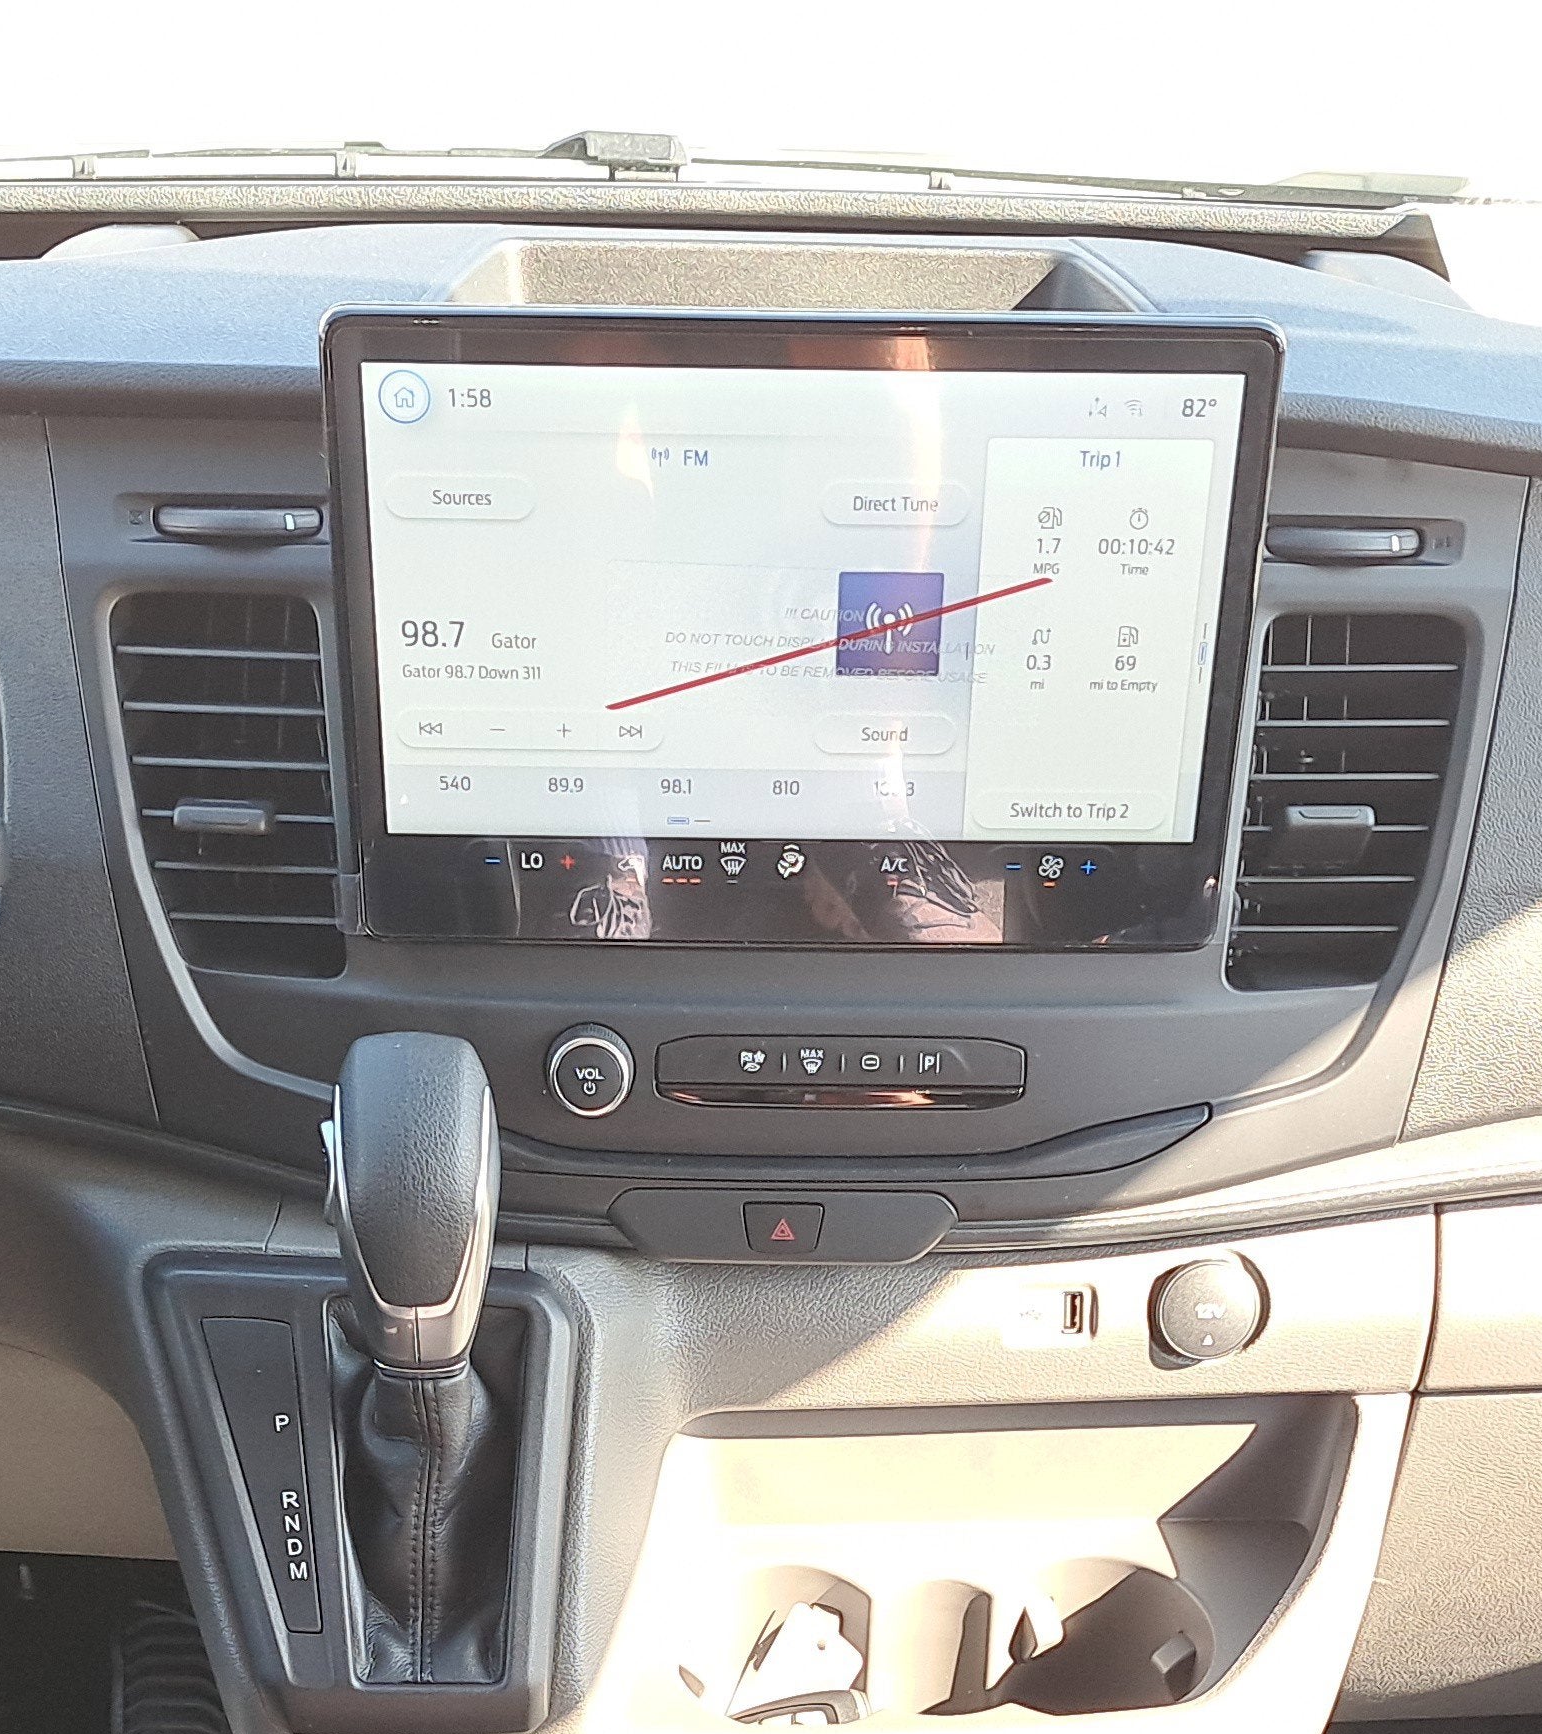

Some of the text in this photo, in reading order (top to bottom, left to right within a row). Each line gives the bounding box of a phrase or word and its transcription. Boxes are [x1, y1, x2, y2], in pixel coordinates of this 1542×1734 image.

[447, 388, 492, 408] 1:58
[683, 449, 708, 466] FM
[1079, 450, 1121, 470] Trip 1
[432, 489, 492, 506] Sources
[853, 496, 939, 512] Direct Tune
[1036, 537, 1062, 555] 1.7
[1097, 538, 1175, 555] 00:10:42
[1033, 563, 1060, 576] MPG
[1119, 563, 1149, 576] Time
[800, 608, 864, 622] CAUTION
[401, 620, 537, 650] 98.7 Gator
[665, 631, 687, 644] DO
[690, 632, 721, 645] NOT
[725, 633, 774, 647] TOUCH
[671, 660, 702, 674] THIS
[1026, 655, 1051, 670] 0.3
[1115, 655, 1136, 671] 69
[402, 664, 541, 680] Gator 98.7 Down 311
[1030, 679, 1044, 690] mi
[1089, 680, 1158, 692] mi to Empty
[861, 726, 908, 742] Sound
[439, 775, 471, 791] 540
[548, 777, 584, 793] 89.9
[660, 778, 693, 795] 98.1
[772, 780, 800, 796] 810
[1010, 802, 1129, 821] Switch to Trip 2
[720, 841, 746, 854] MAX
[520, 852, 543, 870] LO
[662, 854, 703, 871] AUTO
[880, 855, 909, 873] A/C
[800, 1049, 824, 1059] MAX
[575, 1067, 605, 1080] VOL
[274, 1414, 290, 1433] P
[282, 1490, 300, 1510] R
[284, 1513, 301, 1532] N
[287, 1537, 303, 1556] D
[289, 1561, 308, 1581] M
